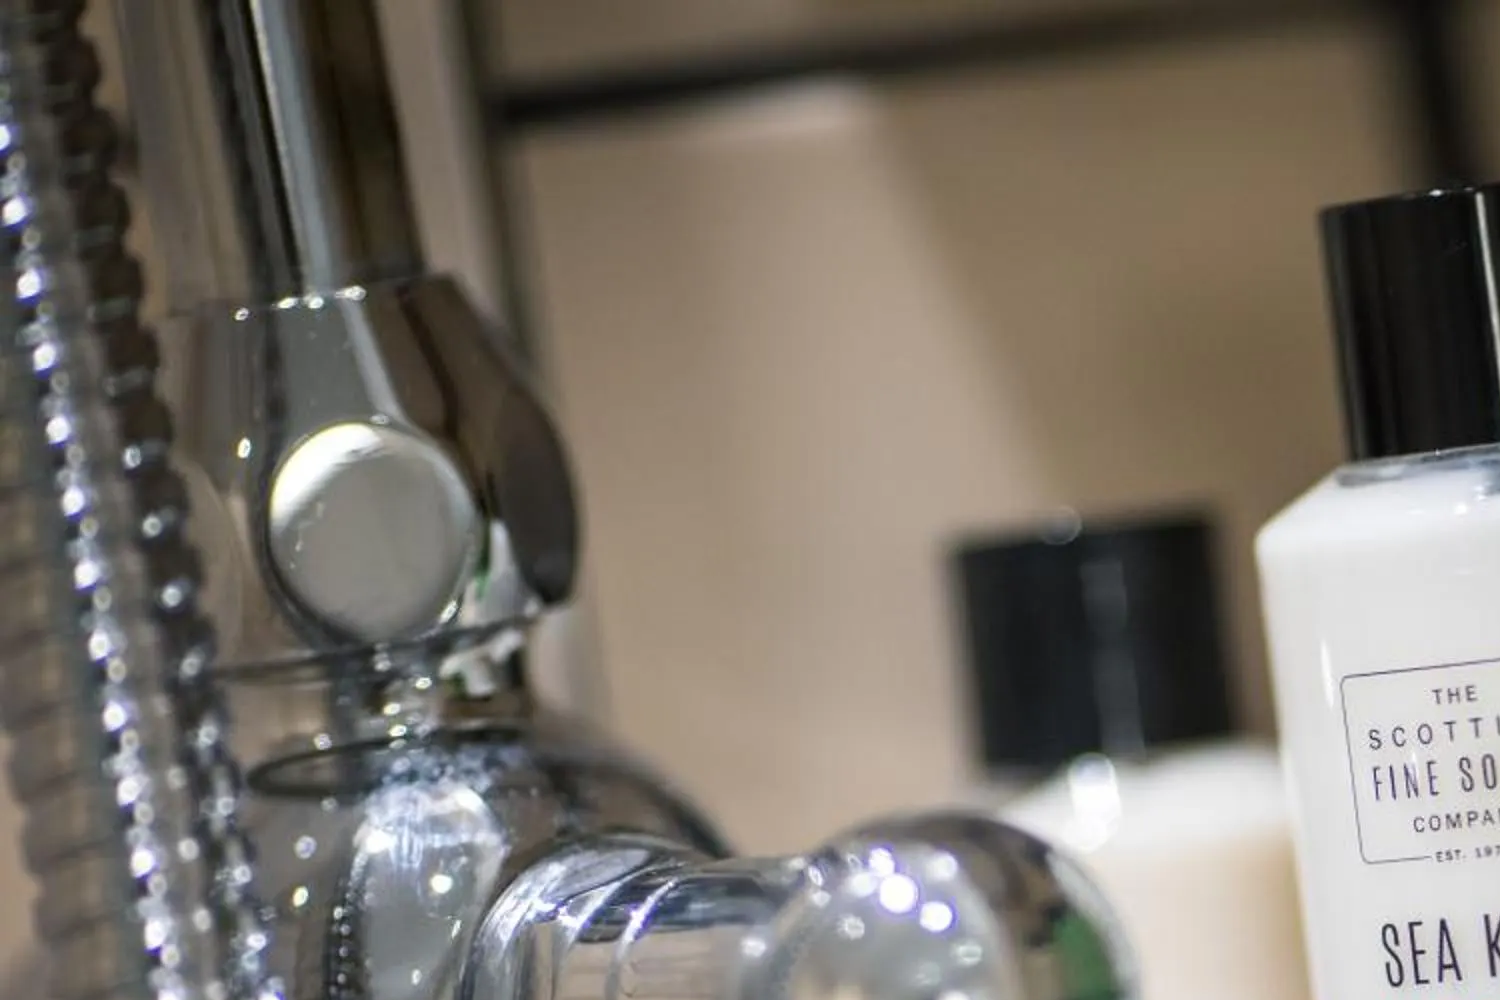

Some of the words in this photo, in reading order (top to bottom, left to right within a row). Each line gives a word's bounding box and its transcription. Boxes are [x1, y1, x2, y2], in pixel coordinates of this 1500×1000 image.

[1432, 684, 1479, 705] THE
[1372, 759, 1441, 801] FINE
[1434, 848, 1467, 863] EST.
[1380, 917, 1463, 988] SEA
